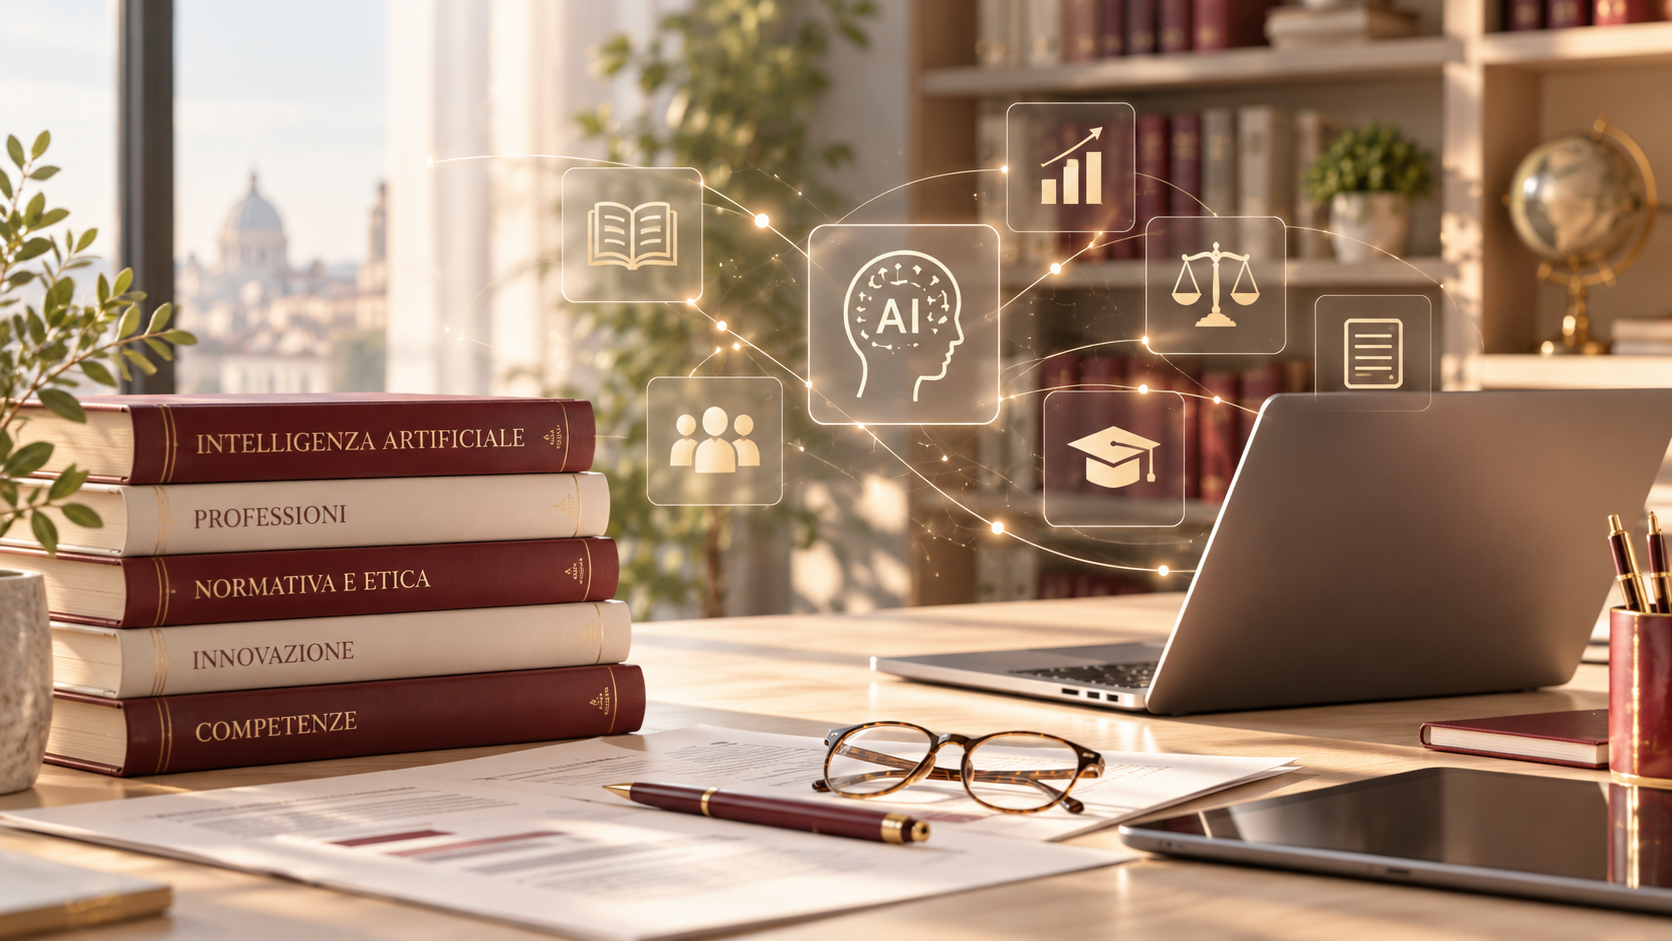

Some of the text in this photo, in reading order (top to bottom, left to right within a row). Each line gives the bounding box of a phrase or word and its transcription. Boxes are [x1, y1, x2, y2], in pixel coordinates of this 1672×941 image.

[196, 431, 377, 455] INTELLIGENZA
[382, 427, 526, 450] ARTIFICIALE
[194, 504, 347, 530] PROFESSIONI
[194, 568, 432, 600] NORMATIVA E ETICA
[193, 640, 355, 670] INNOVAZIONE
[195, 710, 358, 743] COMPETENZE
